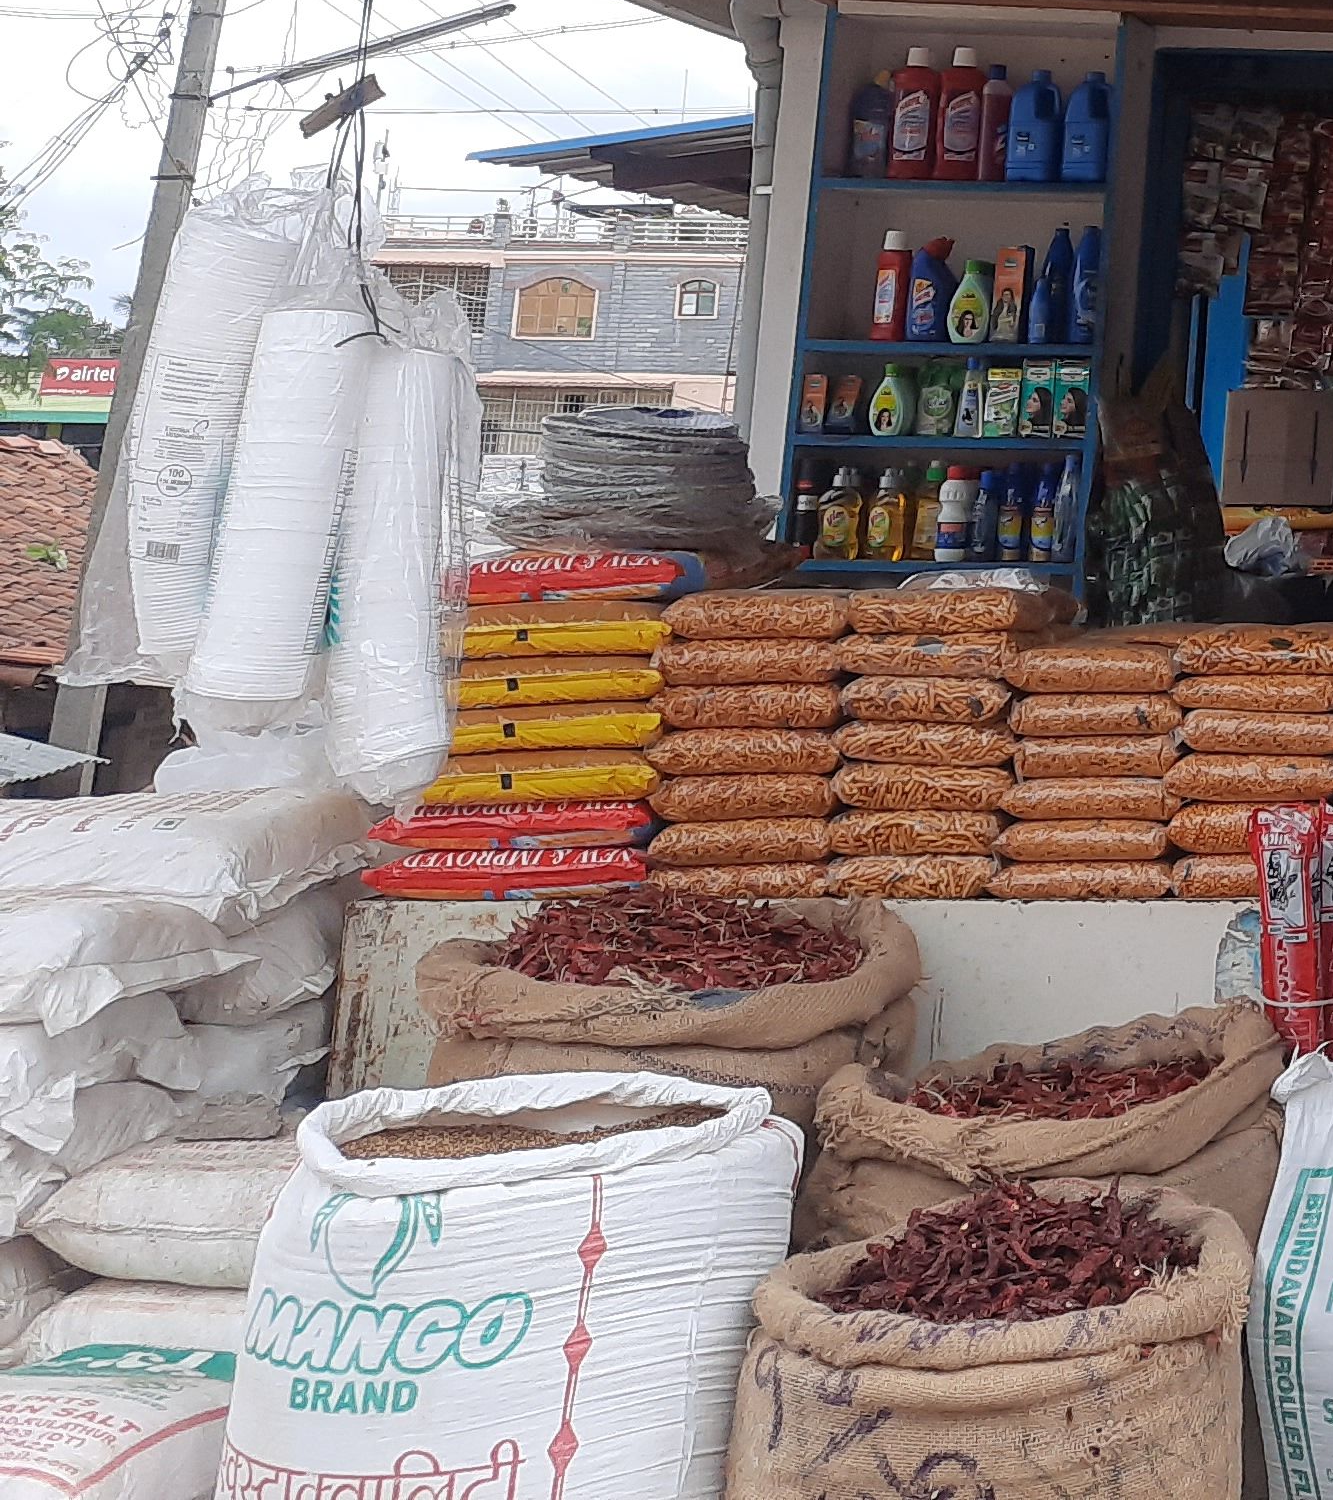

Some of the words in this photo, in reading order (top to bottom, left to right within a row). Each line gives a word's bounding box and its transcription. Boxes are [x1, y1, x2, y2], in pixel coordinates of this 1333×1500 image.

[71, 366, 115, 381] airtel
[402, 852, 542, 869] IMPROVED
[1273, 1193, 1326, 1347] BRINDAVAN
[244, 1287, 535, 1377] MANGO
[289, 1377, 418, 1414] BRAND
[1273, 1355, 1306, 1463] ROLLER
[53, 1408, 142, 1434] SALT
